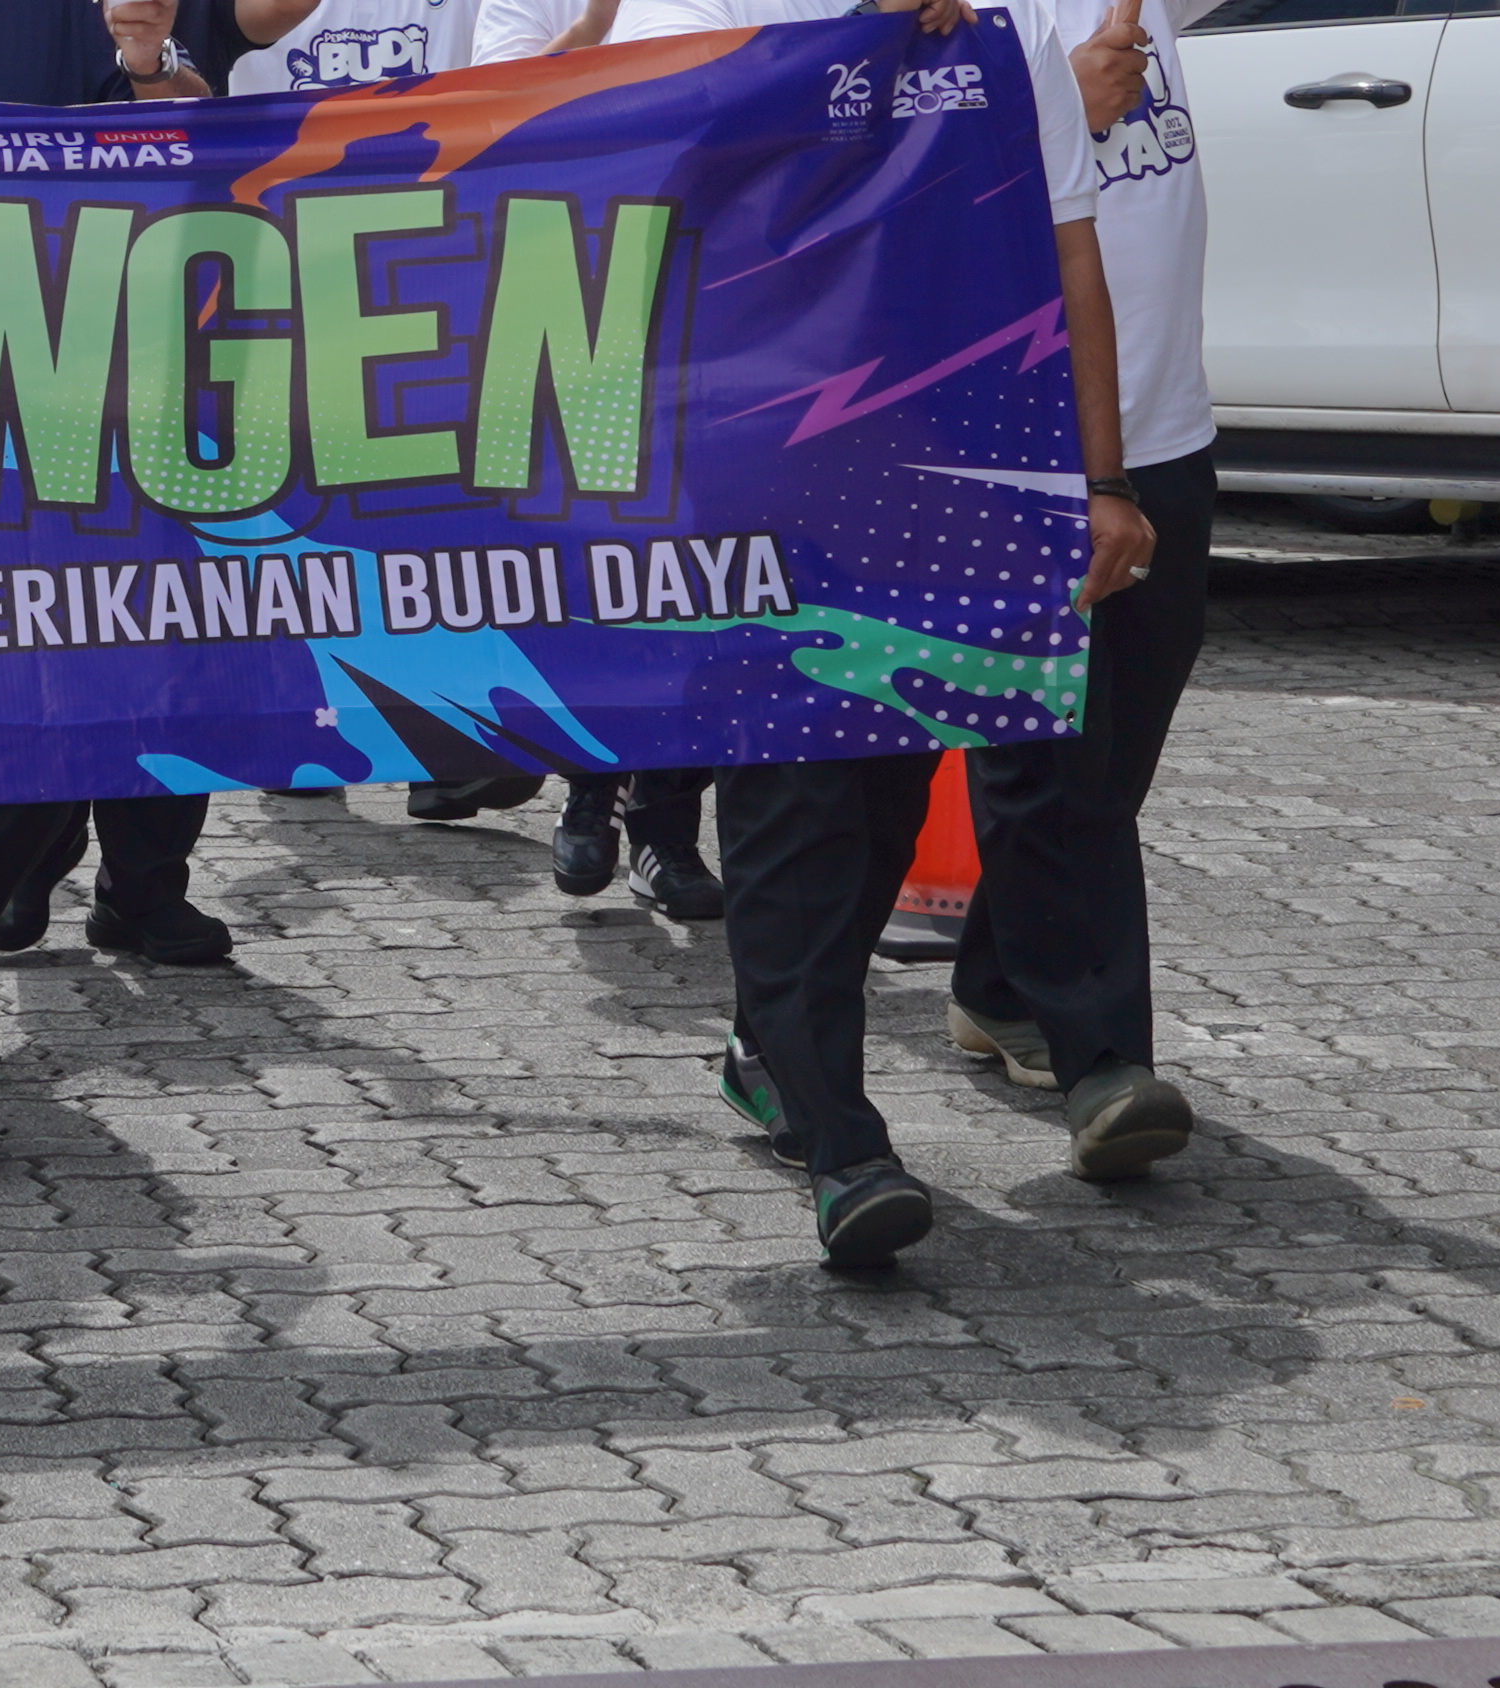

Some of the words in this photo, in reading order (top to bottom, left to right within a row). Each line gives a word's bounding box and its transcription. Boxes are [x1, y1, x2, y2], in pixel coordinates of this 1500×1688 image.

[893, 64, 983, 97] KKP
[828, 102, 873, 118] KKP
[891, 88, 989, 119] 2025
[102, 131, 181, 143] UNTUK
[62, 142, 195, 171] EMAS
[384, 546, 566, 631] BUDI
[589, 534, 794, 622] DAYA
